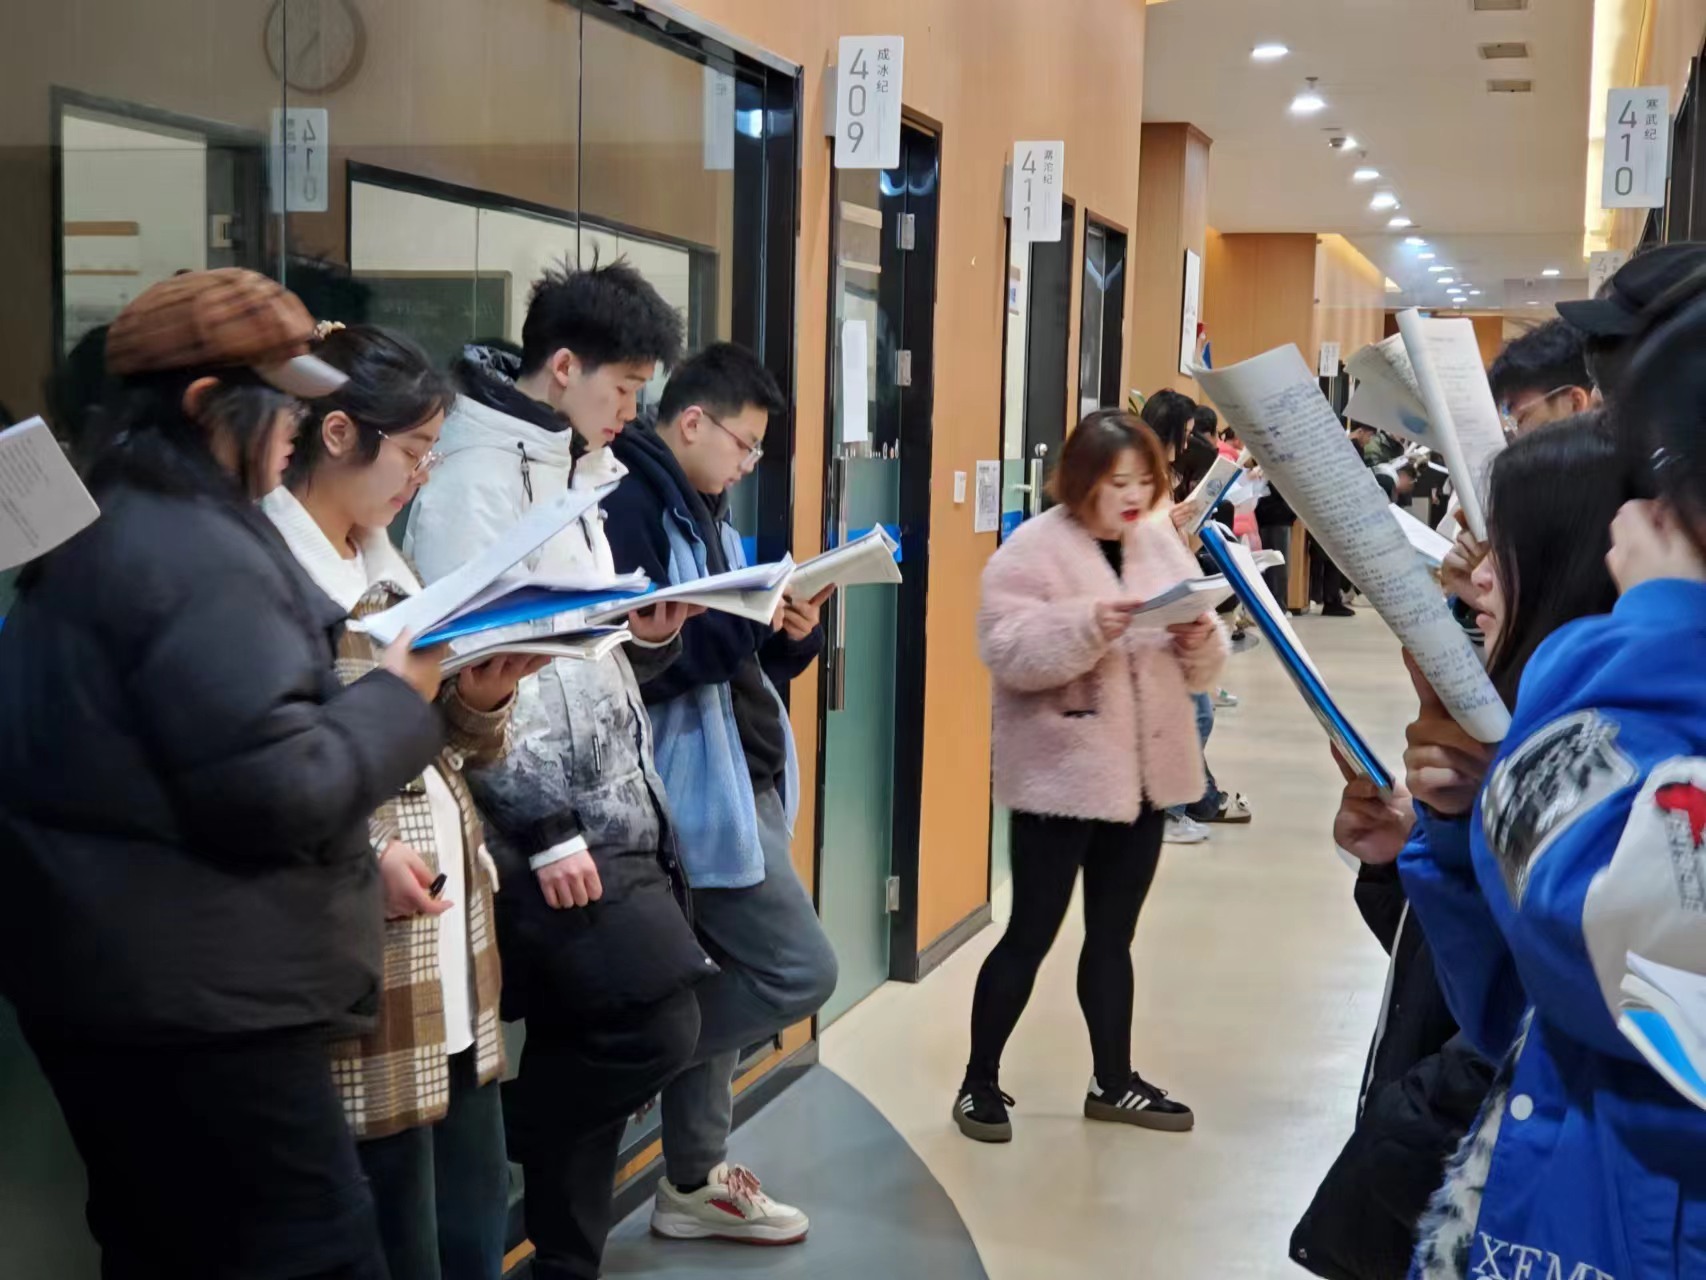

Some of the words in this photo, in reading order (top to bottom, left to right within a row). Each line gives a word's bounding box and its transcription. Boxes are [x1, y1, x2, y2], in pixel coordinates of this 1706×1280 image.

[847, 48, 869, 153] 409
[876, 48, 890, 93] 成冰纪
[1615, 99, 1637, 196] 410
[1644, 98, 1659, 141] 寒武纪
[1021, 150, 1036, 231] 411
